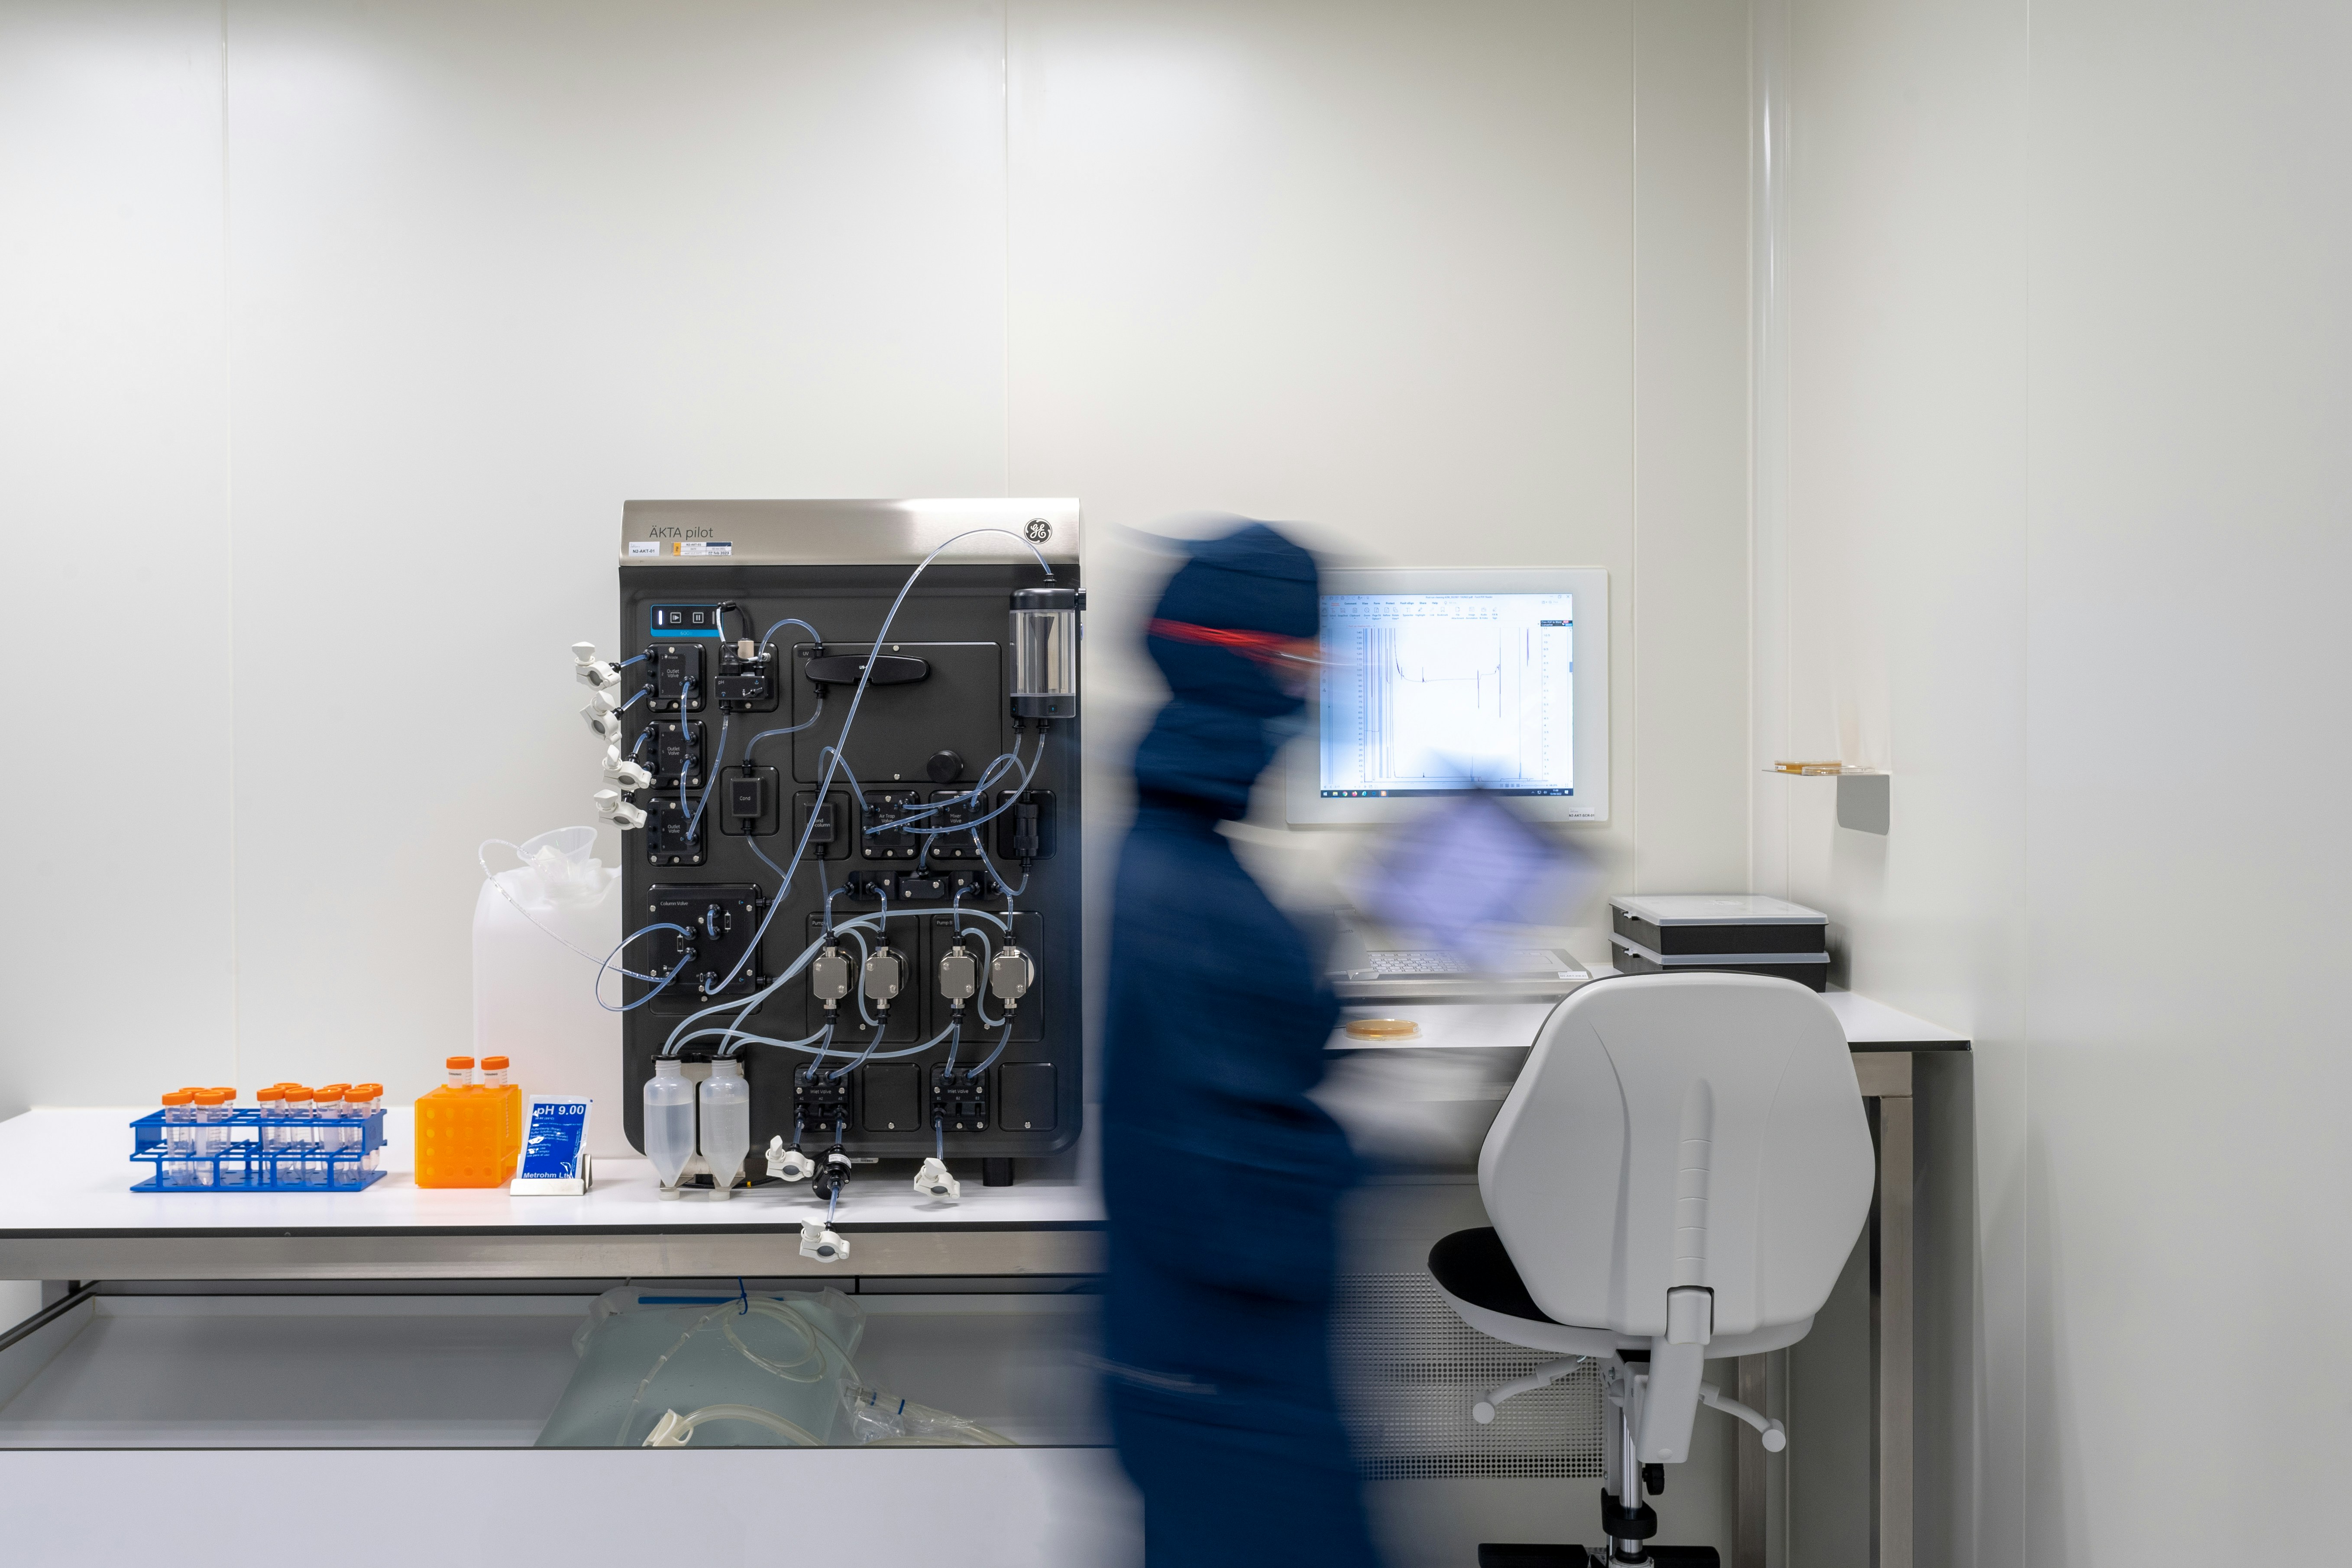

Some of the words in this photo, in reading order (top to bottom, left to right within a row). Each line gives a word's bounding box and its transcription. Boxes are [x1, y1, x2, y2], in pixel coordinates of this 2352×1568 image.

[649, 525, 682, 538] ÄKTA
[686, 527, 713, 540] pilot
[537, 1105, 554, 1116] pH
[559, 1105, 584, 1115] 9.00
